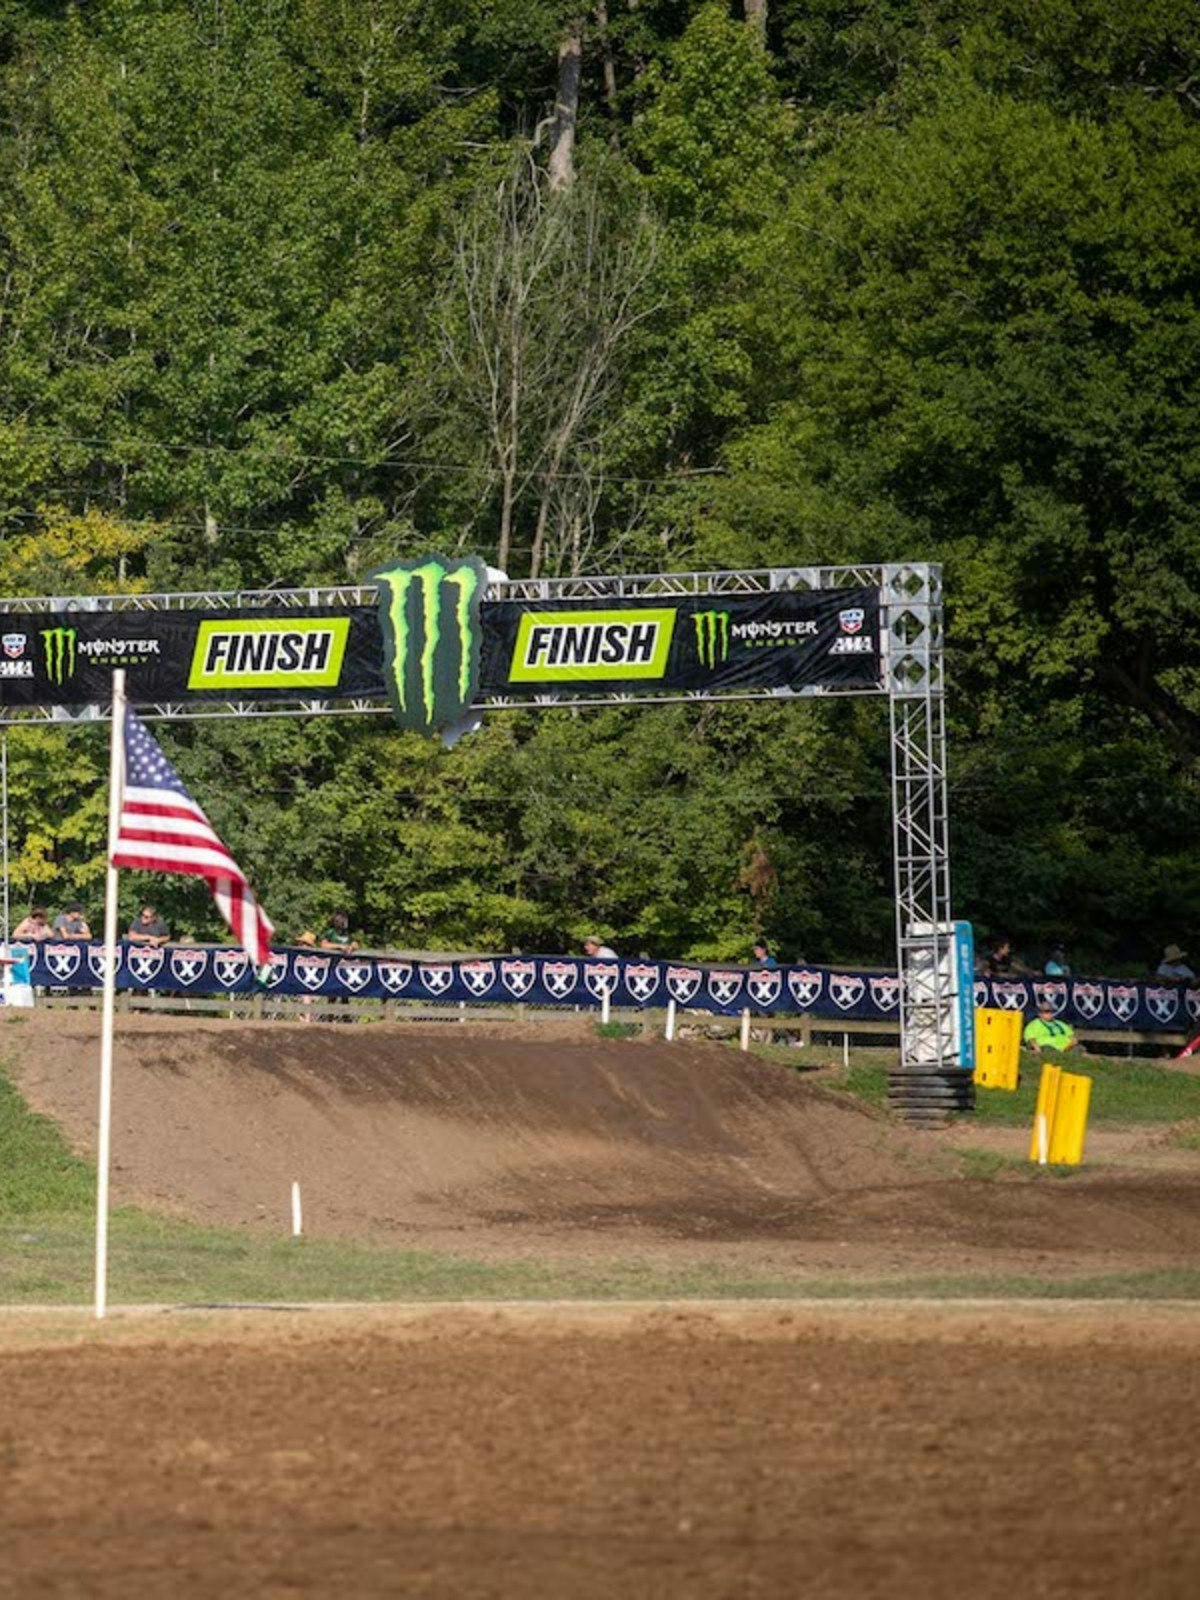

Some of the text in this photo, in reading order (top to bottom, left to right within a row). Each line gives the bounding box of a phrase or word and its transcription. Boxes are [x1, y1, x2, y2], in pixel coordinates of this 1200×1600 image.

[731, 620, 819, 638] MONSTER
[78, 638, 160, 656] MONSTER
[527, 624, 656, 665] FINISH
[745, 639, 806, 647] ENERGY
[828, 636, 875, 654] AMA
[205, 633, 331, 672] FINISH
